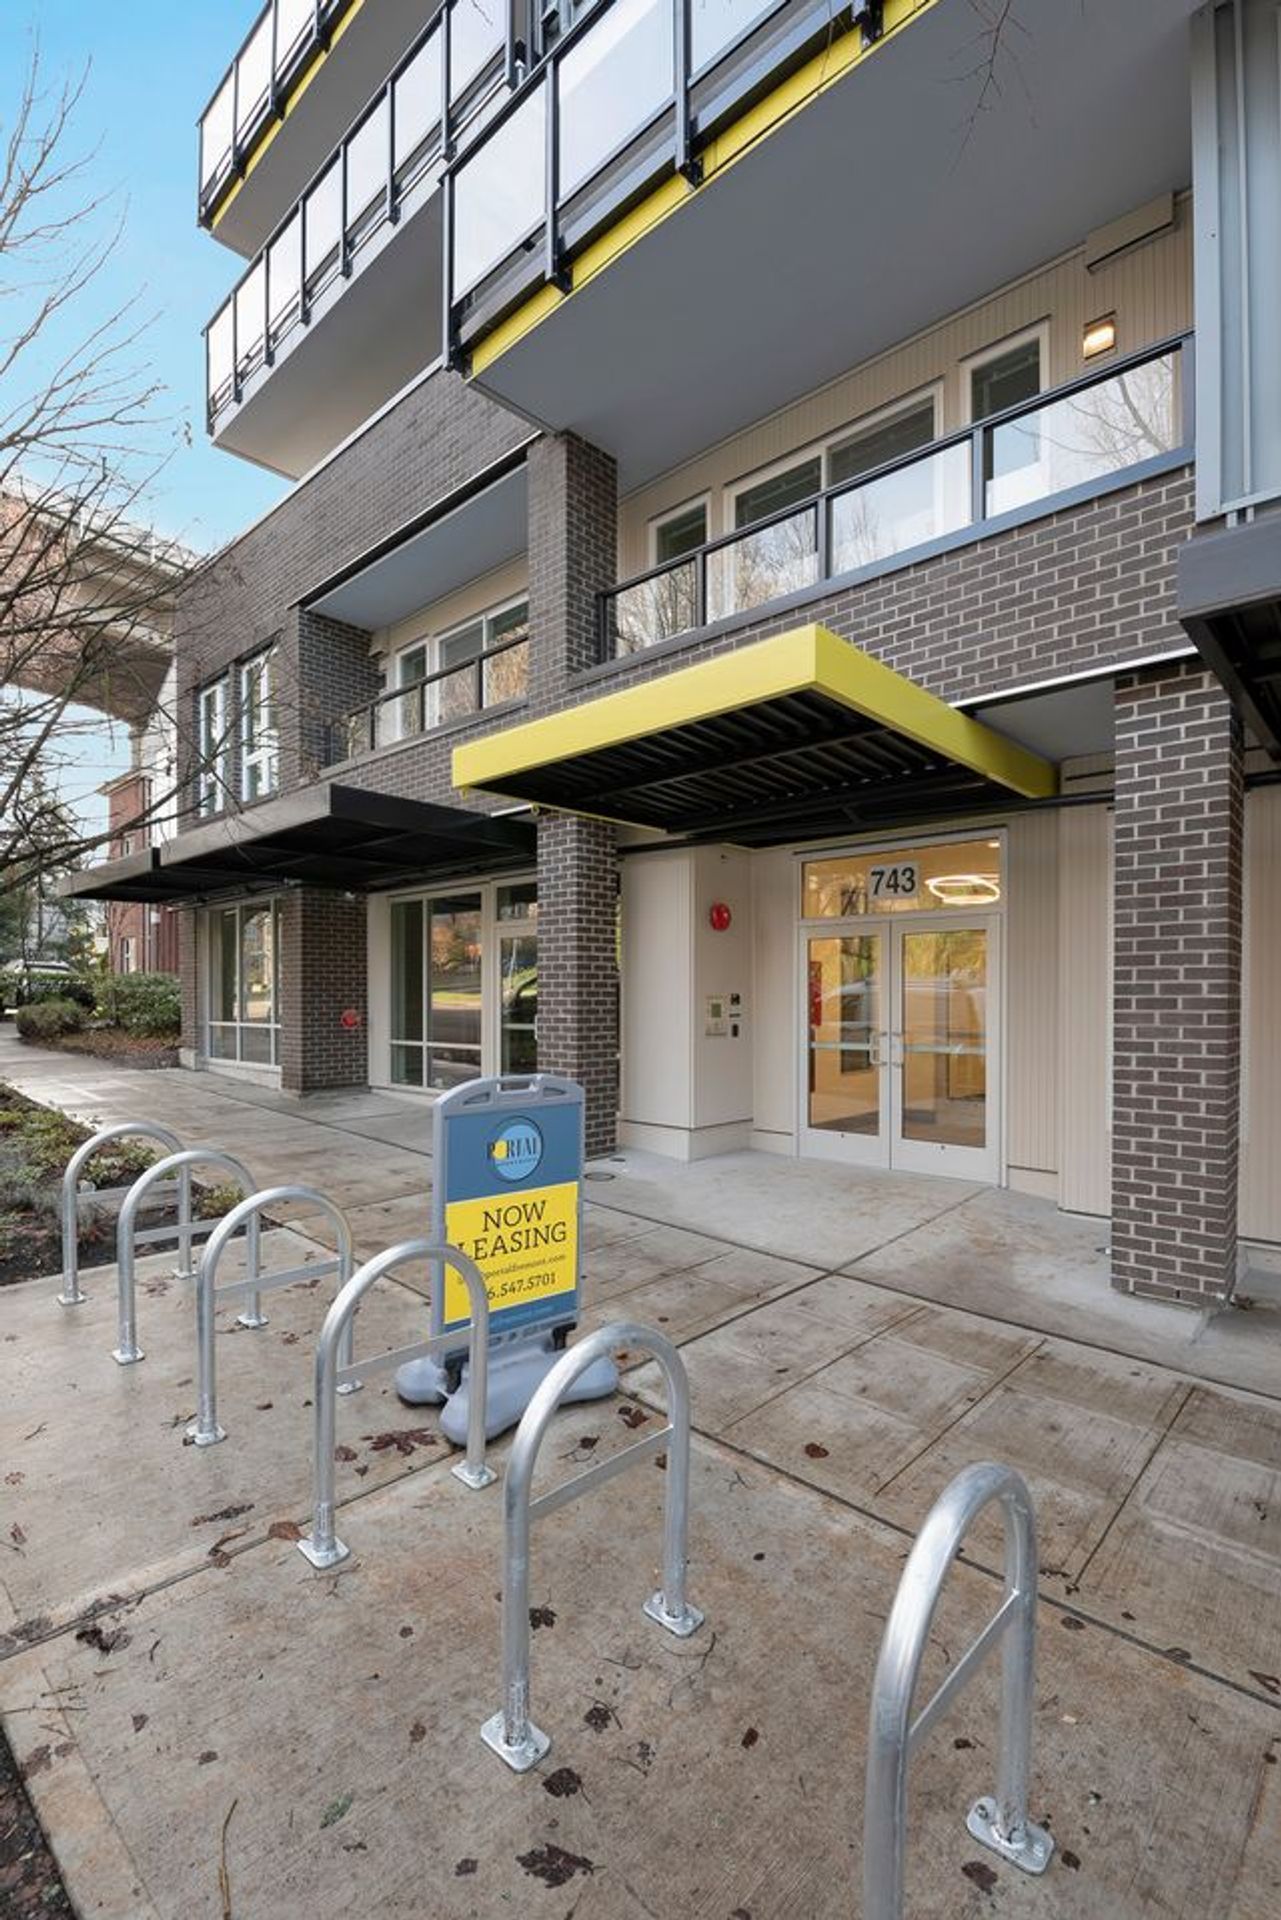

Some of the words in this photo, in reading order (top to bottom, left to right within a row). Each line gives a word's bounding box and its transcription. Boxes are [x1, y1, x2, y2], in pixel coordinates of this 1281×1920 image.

[871, 866, 915, 895] 743
[482, 1200, 546, 1232] NOW
[486, 1272, 556, 1300] 6.547.5701
